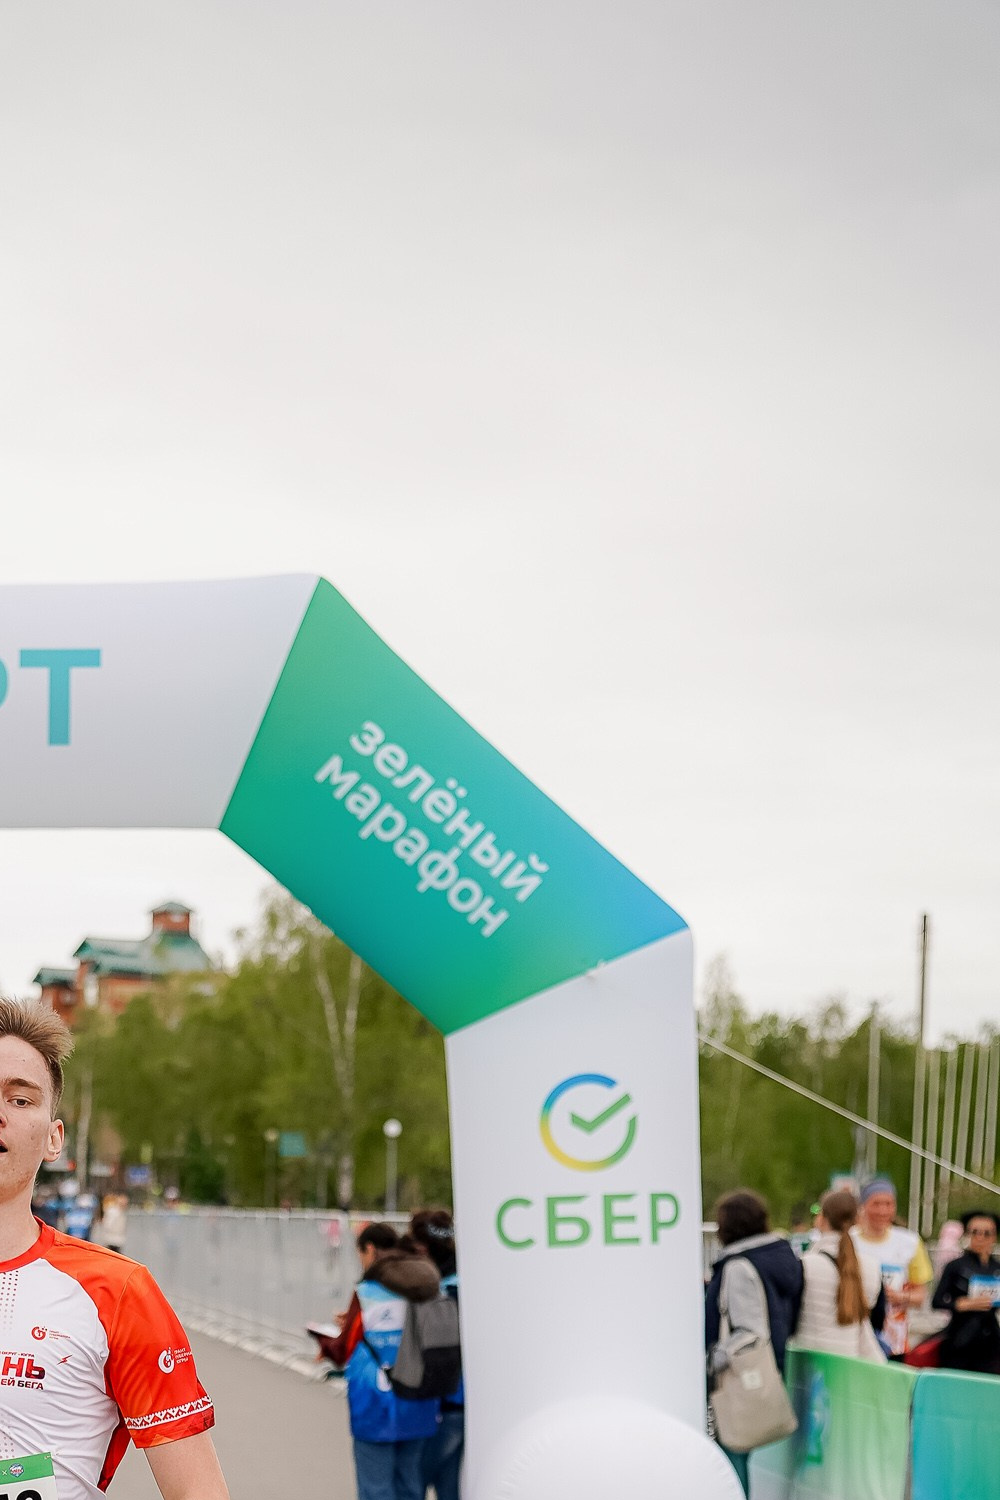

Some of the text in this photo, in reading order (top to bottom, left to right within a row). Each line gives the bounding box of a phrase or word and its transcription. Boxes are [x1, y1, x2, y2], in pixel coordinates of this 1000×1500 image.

[313, 753, 510, 938] марафон
[349, 720, 550, 903] зелёный
[496, 1193, 680, 1249] СБЕР
[17, 1380, 44, 1390] БЕГА
